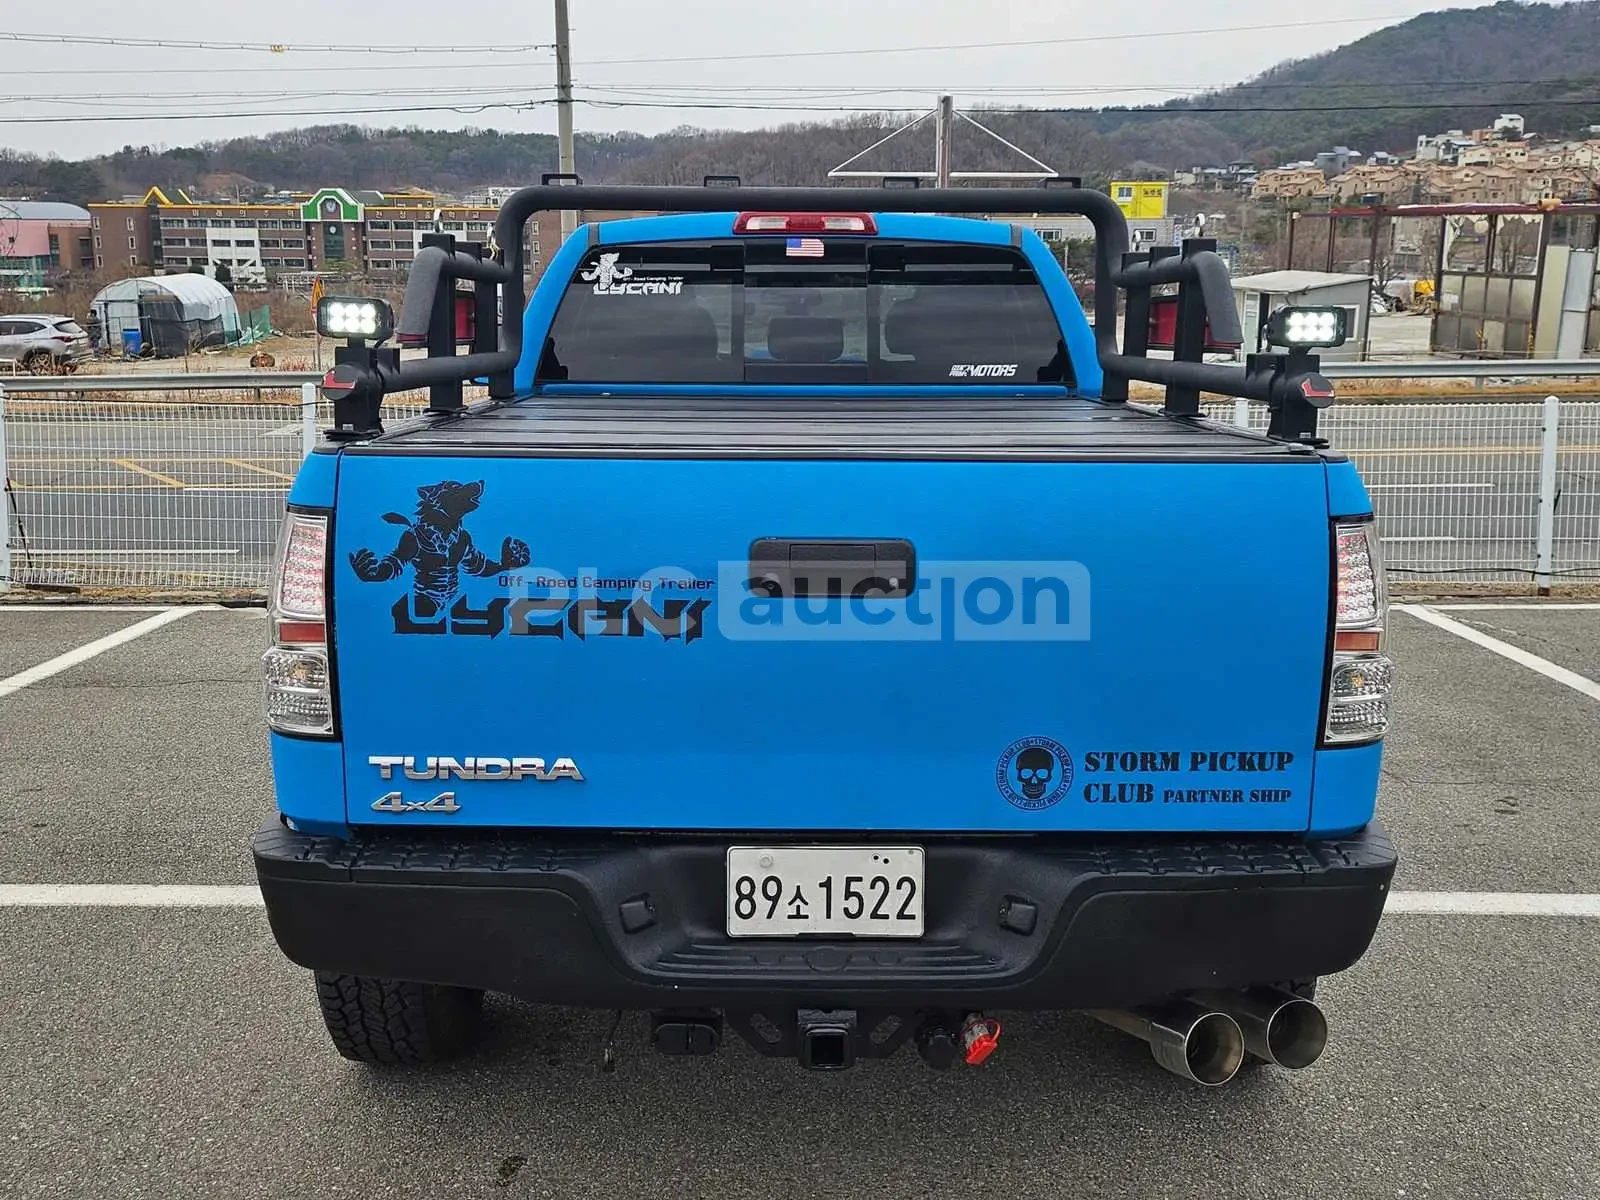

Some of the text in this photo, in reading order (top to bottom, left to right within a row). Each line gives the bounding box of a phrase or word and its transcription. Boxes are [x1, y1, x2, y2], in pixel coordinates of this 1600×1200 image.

[970, 364, 1018, 377] MOTORS
[582, 576, 652, 592] Camping
[659, 576, 716, 590] Trailer
[368, 756, 585, 781] TUNDRA
[1084, 751, 1294, 772] STORM PICKUP
[370, 791, 462, 813] 4x4
[1083, 783, 1292, 803] CLUB PARTNER SHIP
